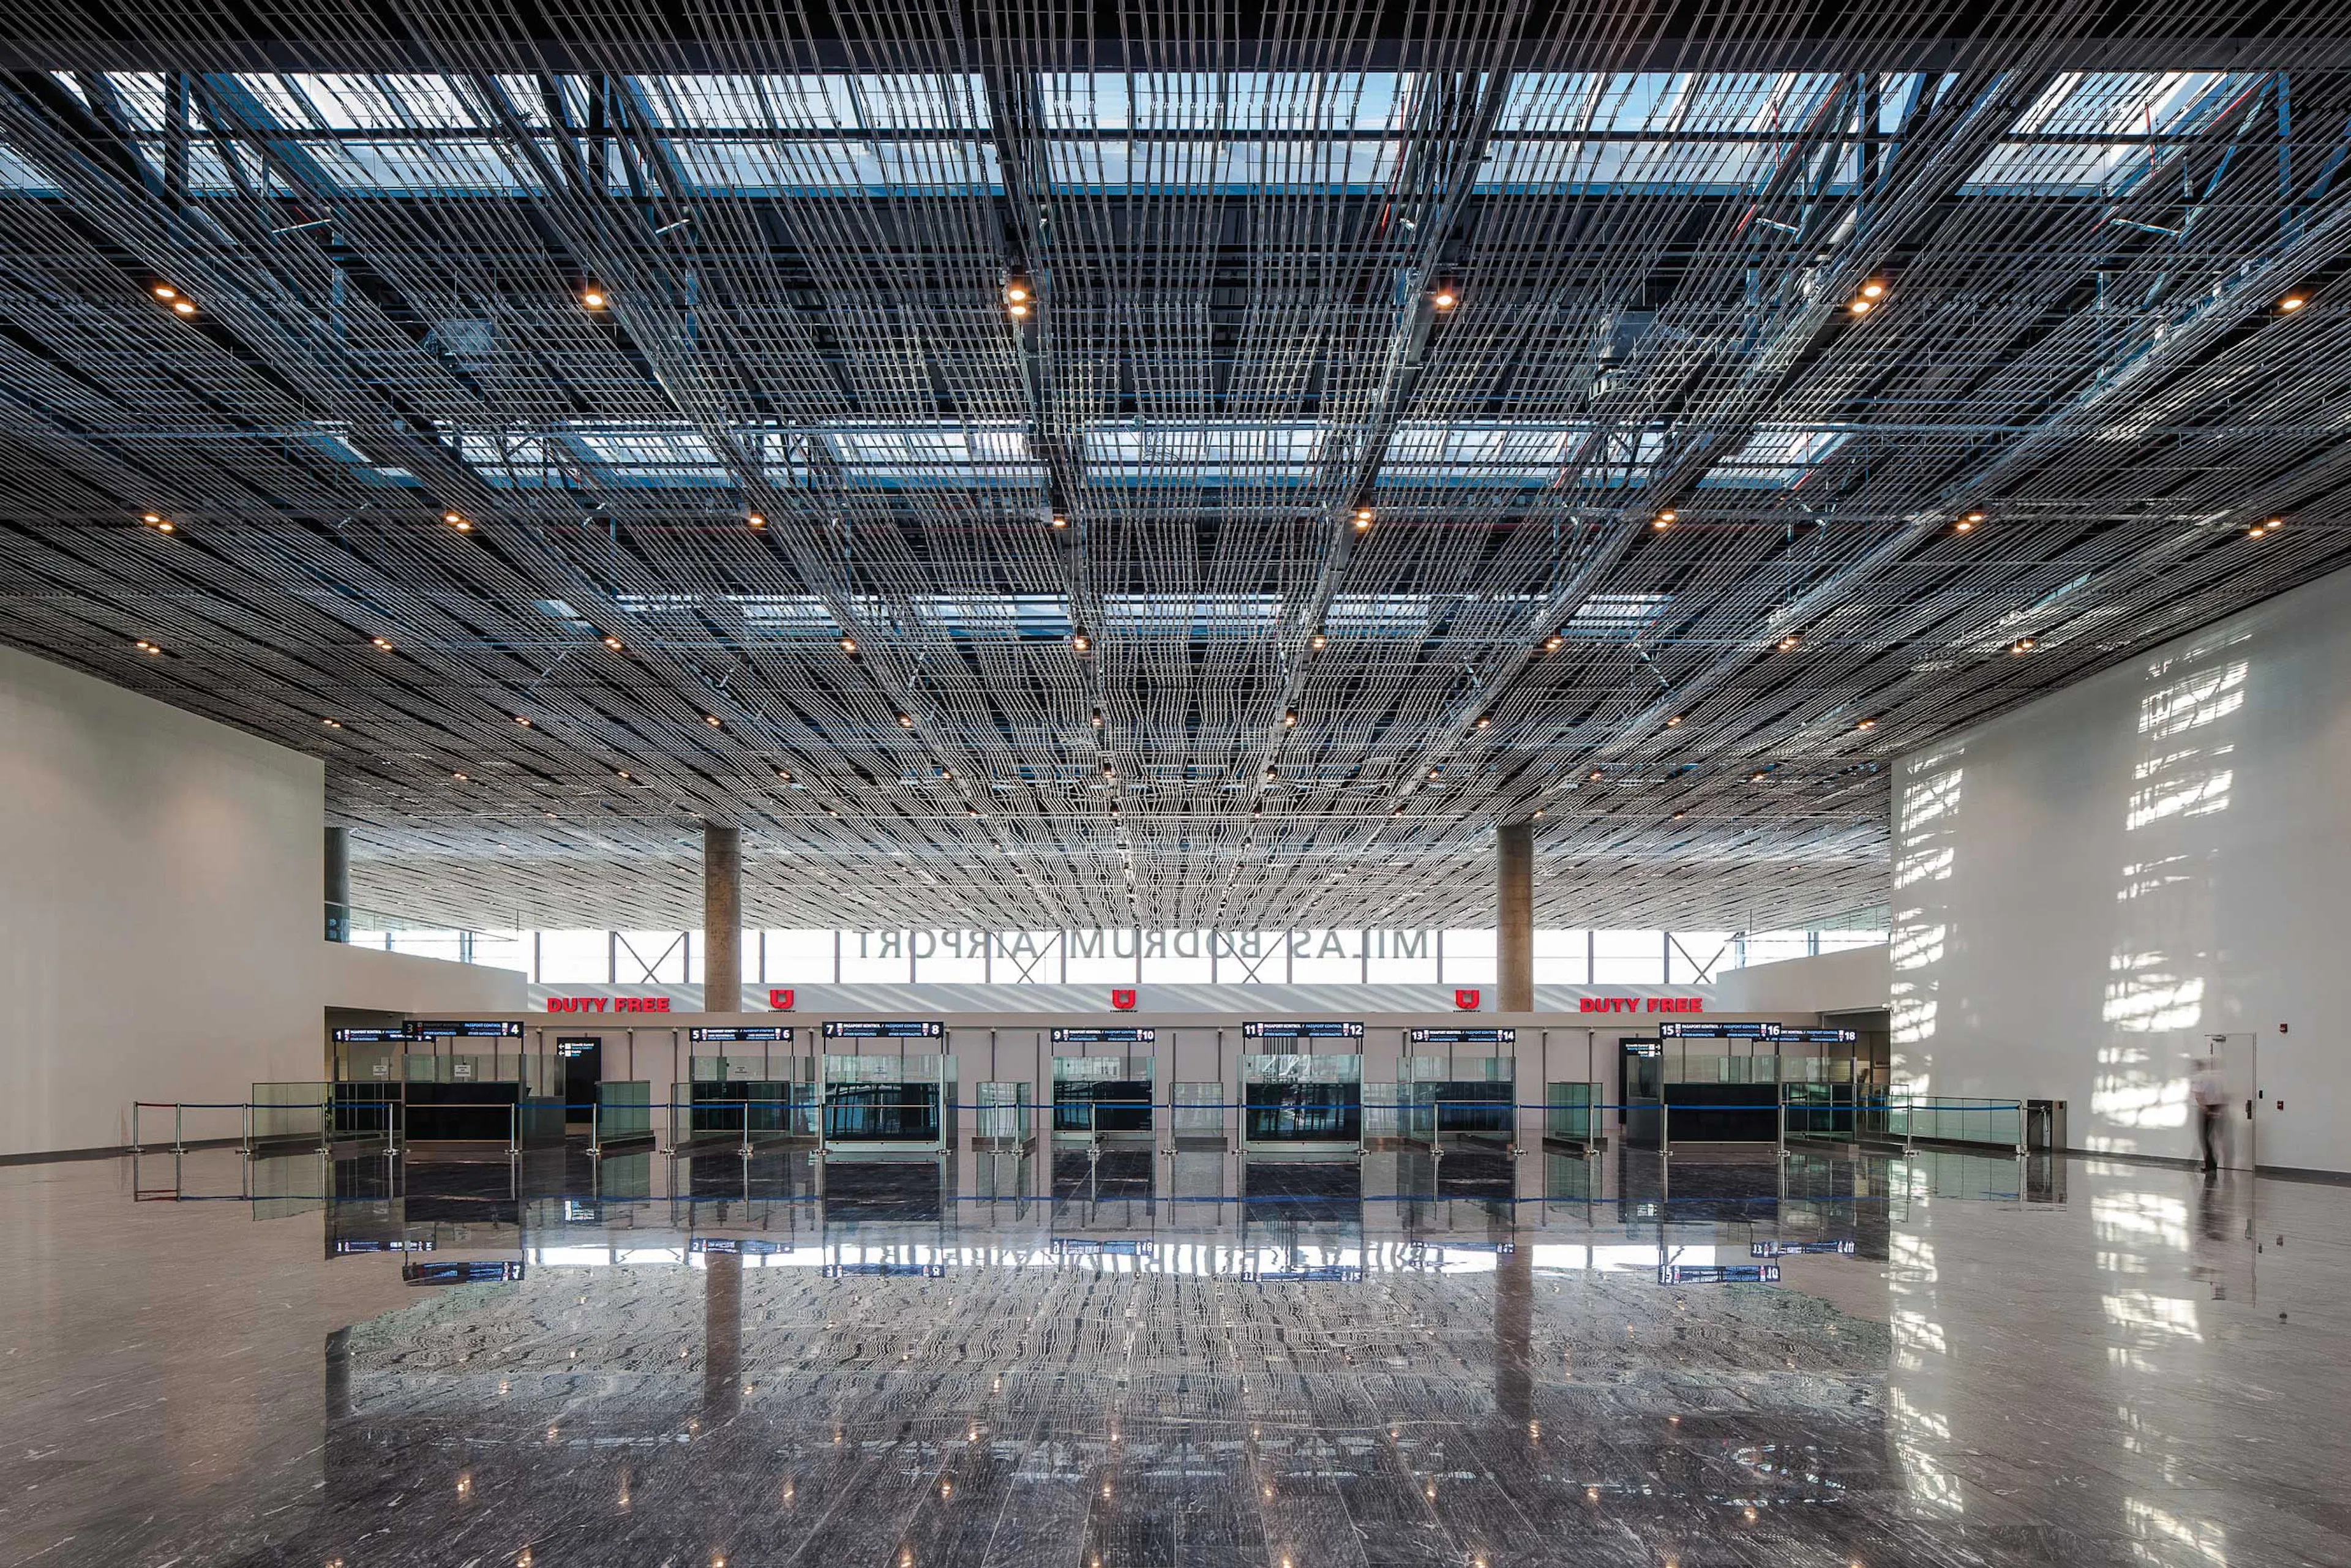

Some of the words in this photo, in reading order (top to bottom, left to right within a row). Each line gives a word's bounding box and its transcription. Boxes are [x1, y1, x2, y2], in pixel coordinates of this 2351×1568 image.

[547, 998, 607, 1013] DUTY
[615, 998, 670, 1013] FREE
[1580, 998, 1640, 1013] DUTY
[1648, 998, 1703, 1013] FREE
[511, 1024, 519, 1034] 4
[827, 1025, 833, 1034] 7
[932, 1025, 939, 1034] 8
[1245, 1025, 1255, 1034] 11
[1350, 1025, 1362, 1035] 12
[1662, 1026, 1674, 1035] 15
[1768, 1026, 1780, 1035] 16
[336, 1030, 341, 1040] 1
[693, 1030, 699, 1039] 5
[783, 1030, 789, 1038] 6
[1054, 1030, 1060, 1039] 9
[1142, 1031, 1153, 1040] 10
[1412, 1032, 1423, 1040] 13
[1504, 1032, 1514, 1040] 14
[1845, 1032, 1855, 1040] 18
